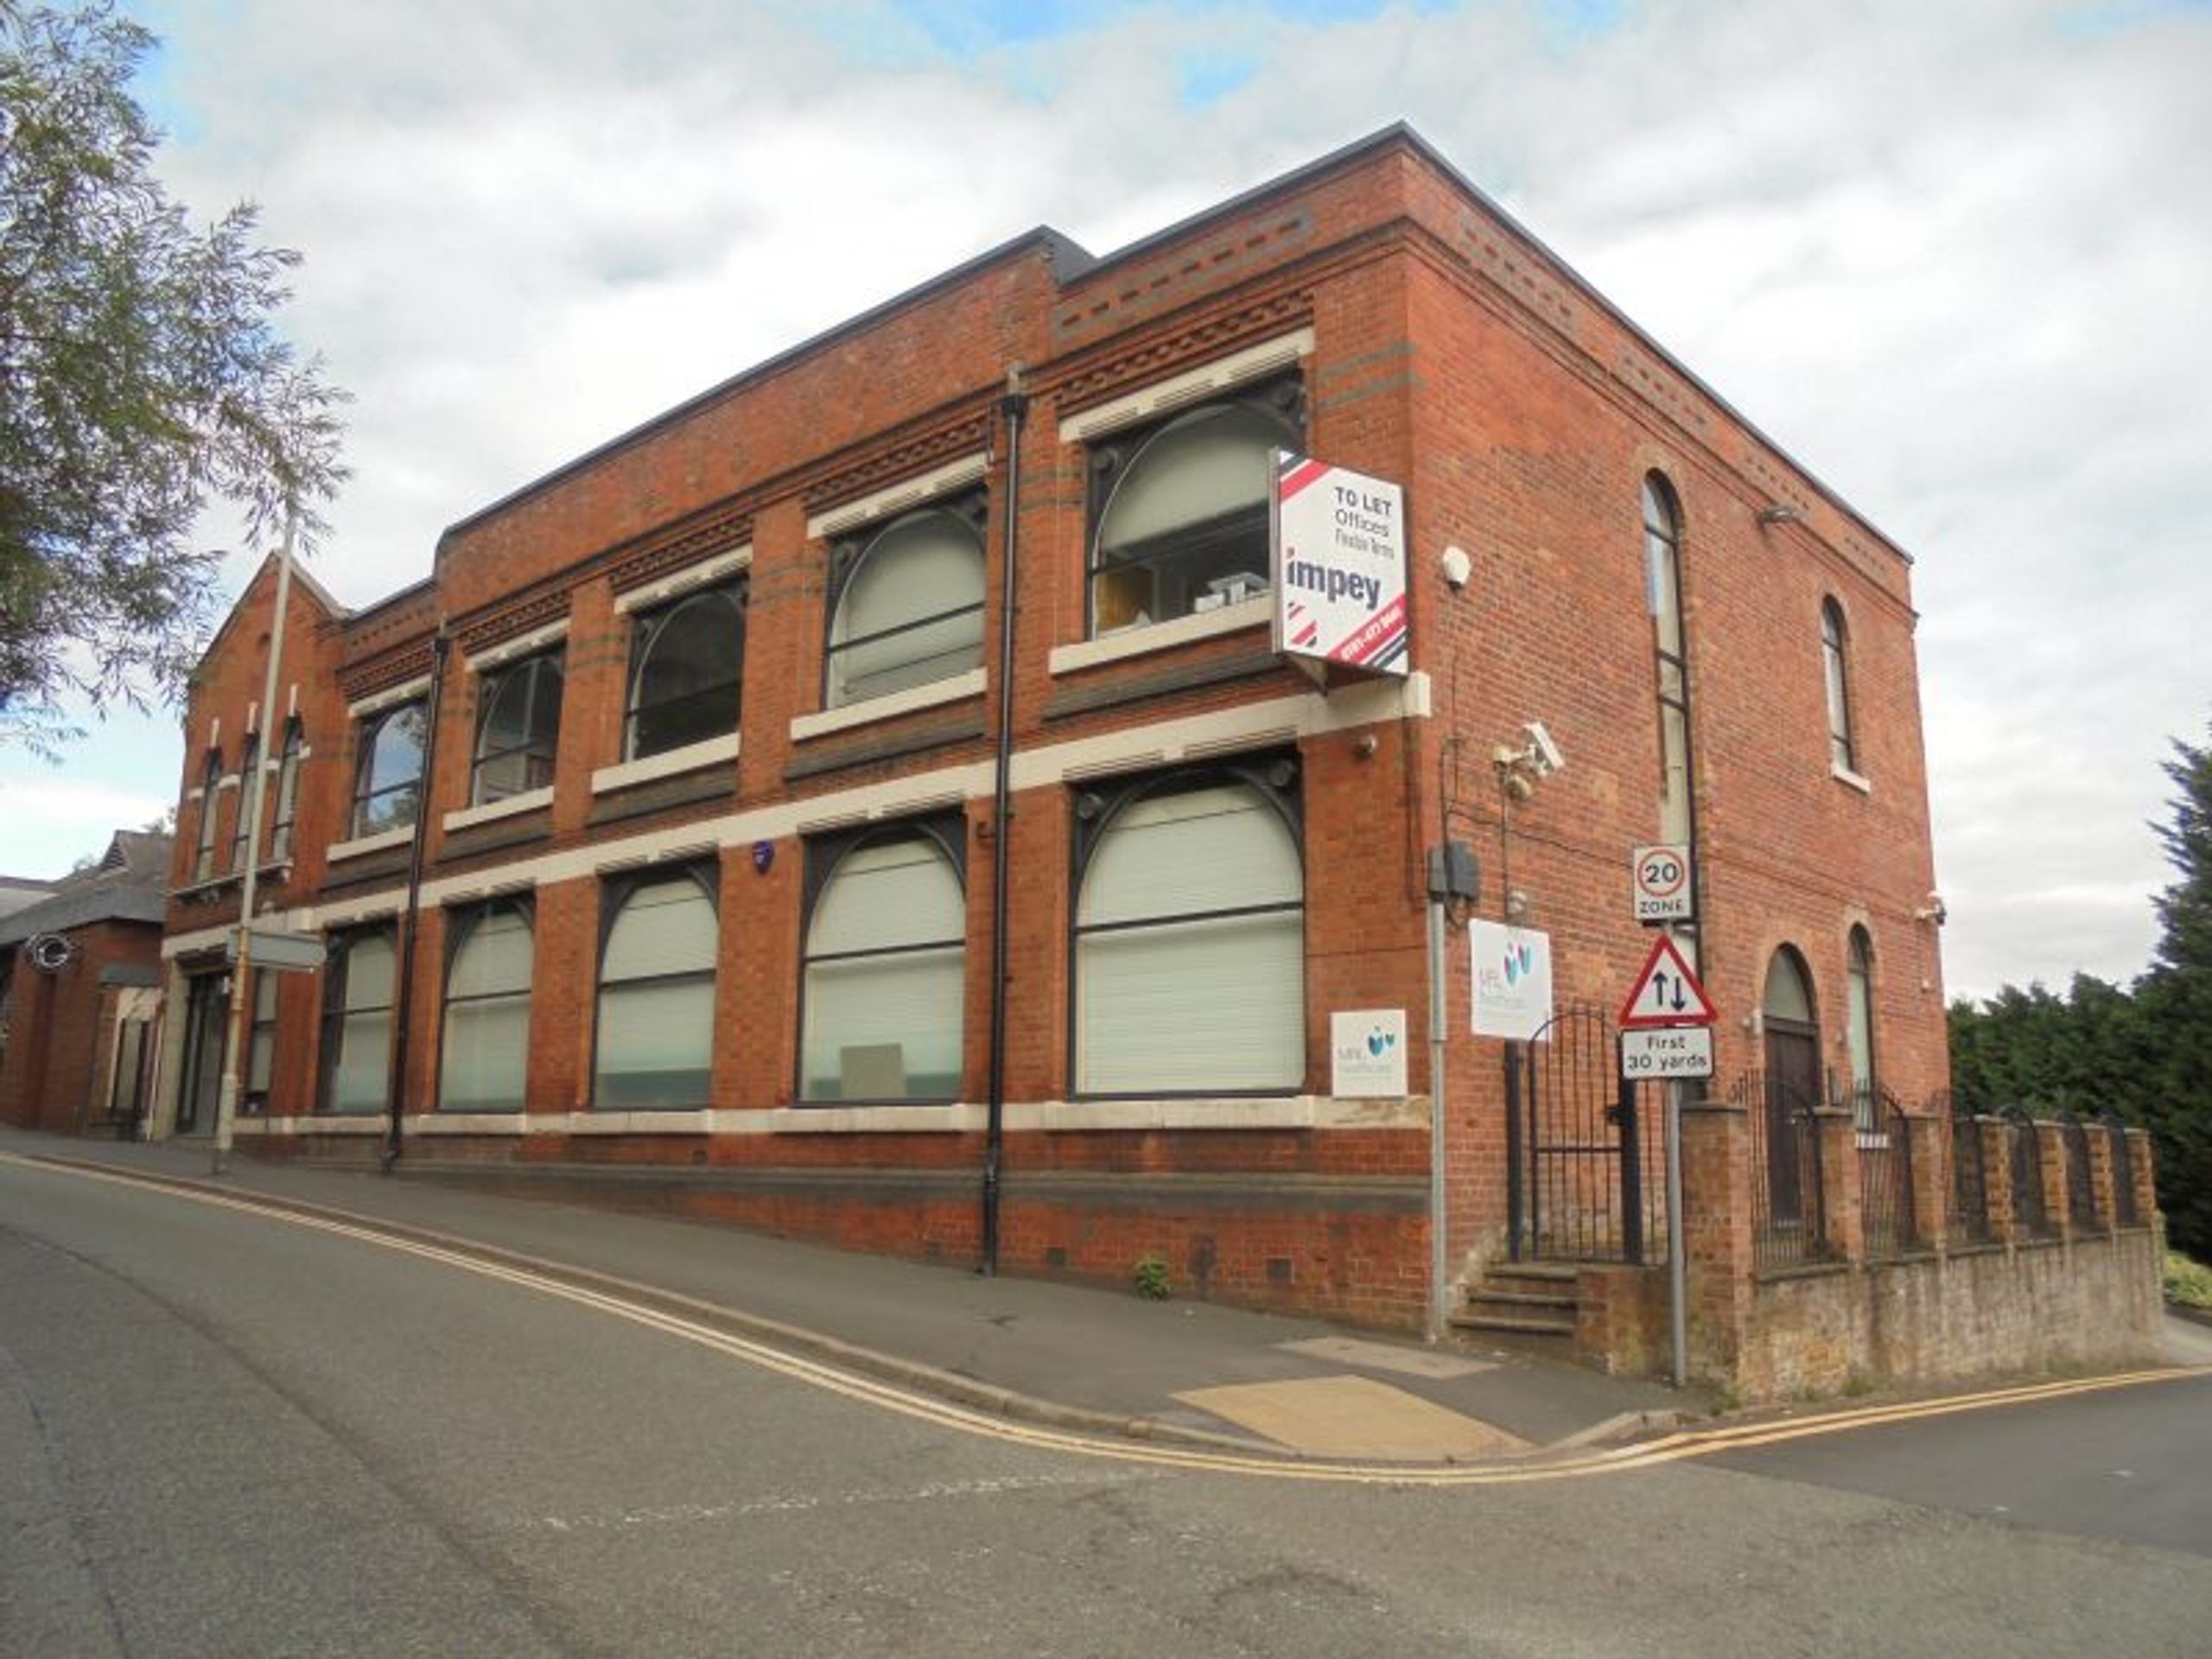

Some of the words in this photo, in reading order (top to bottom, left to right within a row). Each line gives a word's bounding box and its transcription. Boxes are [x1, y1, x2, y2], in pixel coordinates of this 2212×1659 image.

[1334, 486, 1357, 507] TO
[1363, 493, 1392, 517] LET
[1335, 509, 1389, 537] Offices
[1287, 546, 1382, 610] impey
[1644, 862, 1678, 884] 20
[1639, 899, 1683, 914] ZONE
[1647, 1035, 1686, 1050] First
[1628, 1055, 1652, 1070] 30
[1659, 1054, 1707, 1071] yards
